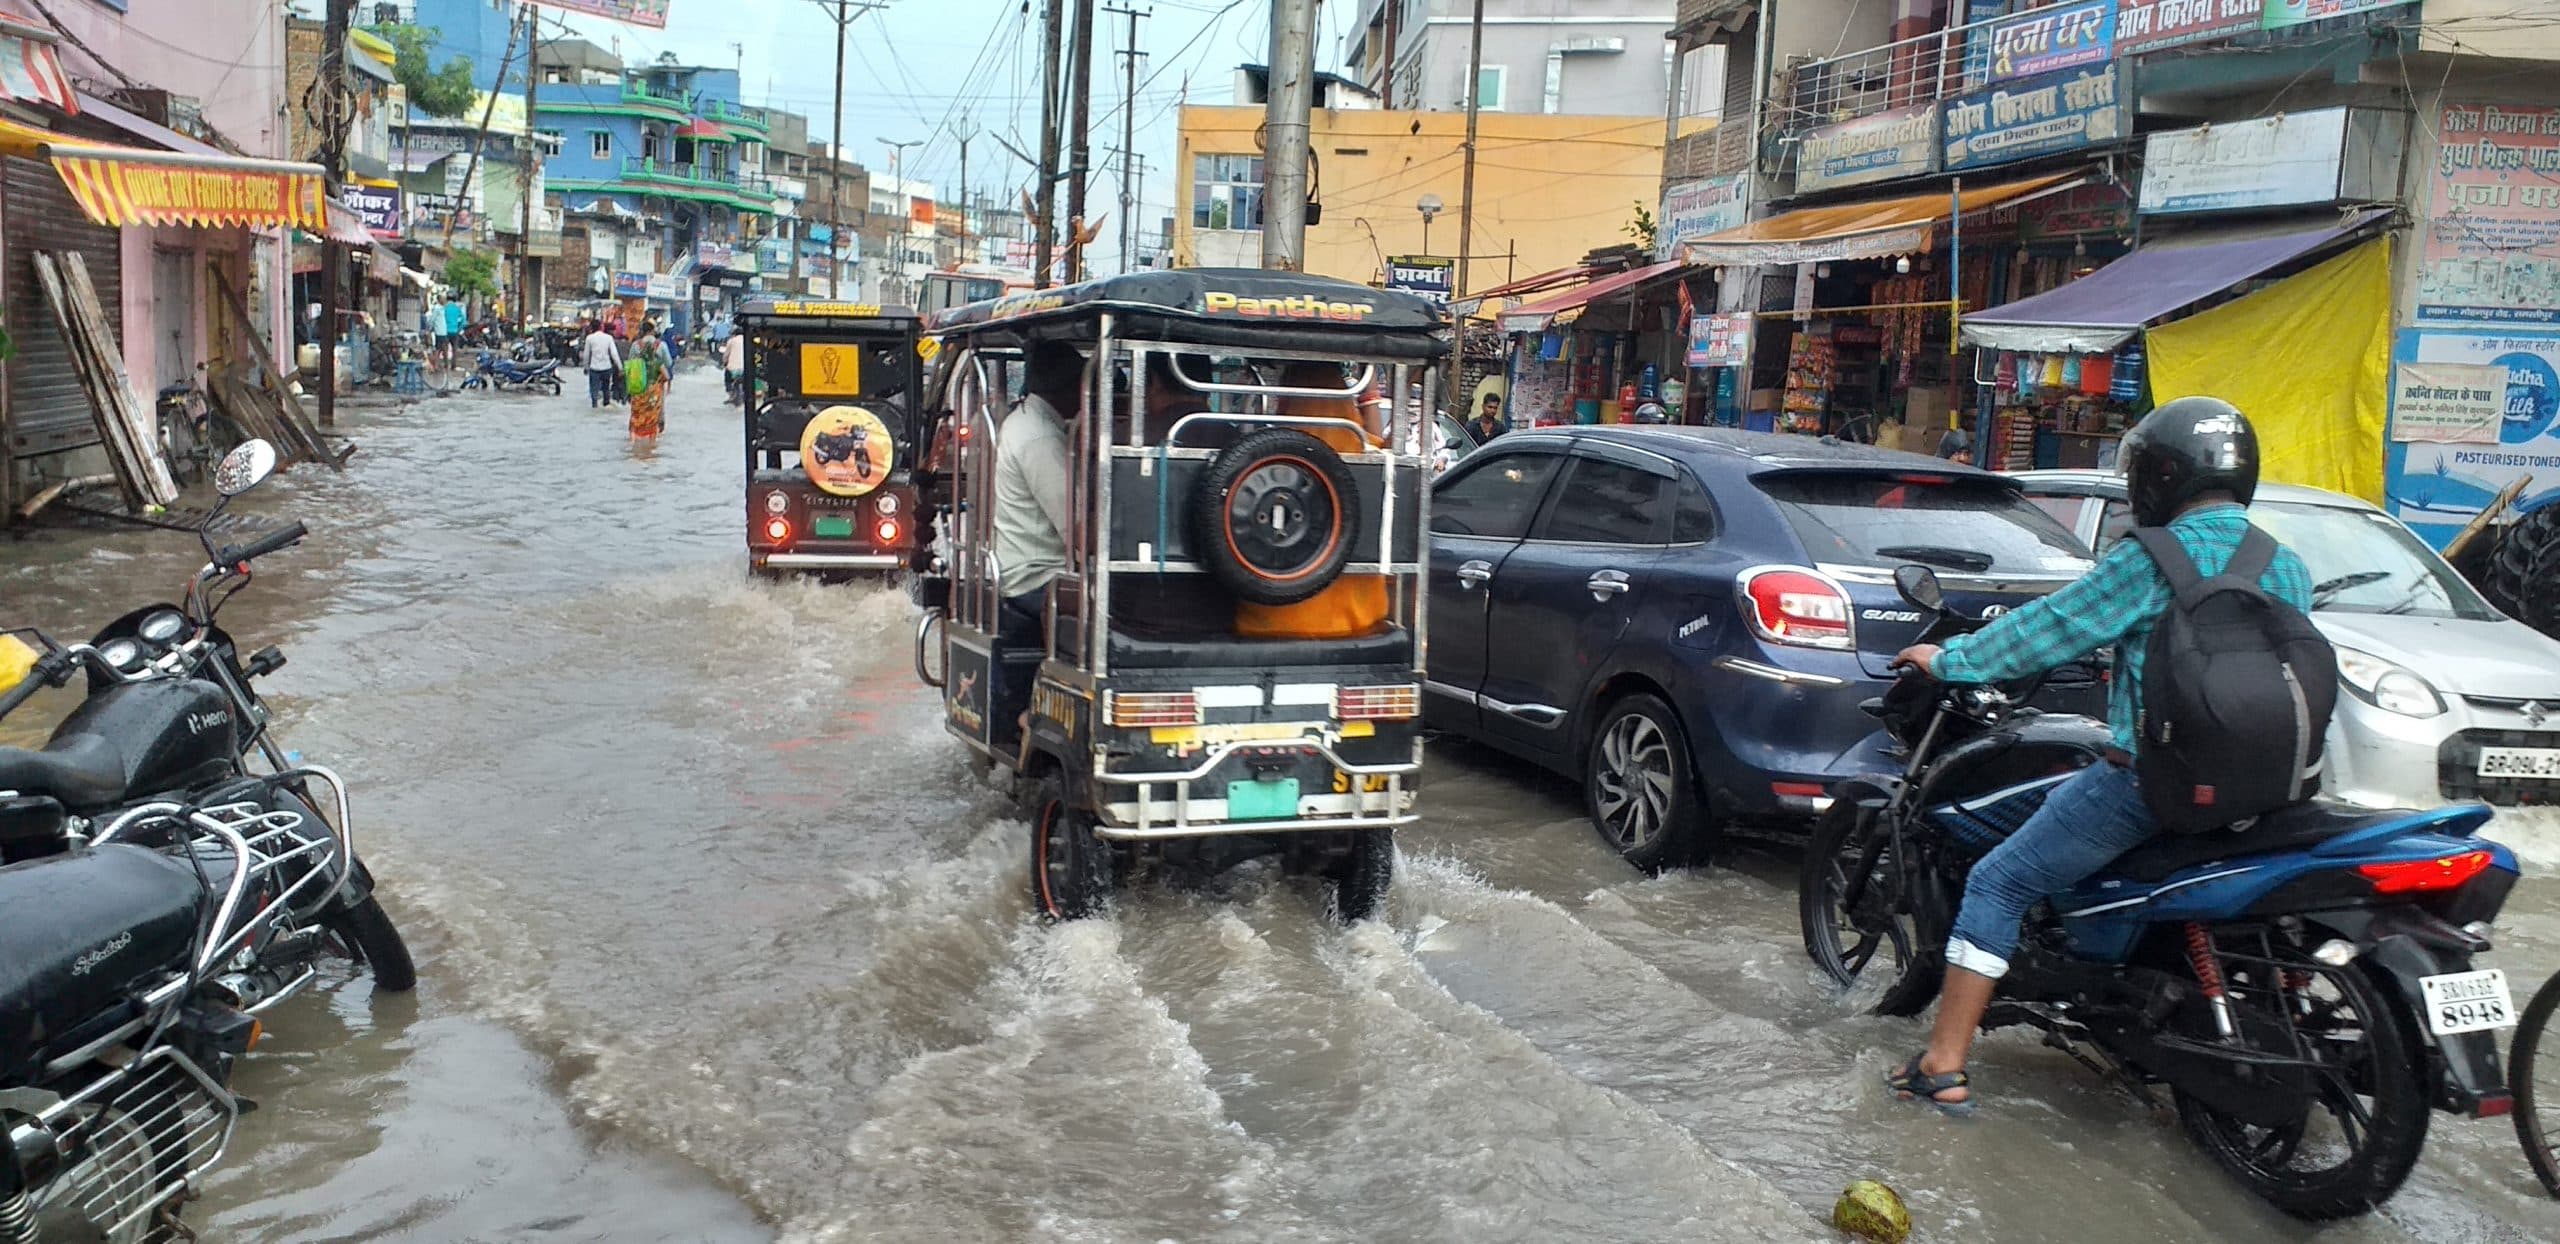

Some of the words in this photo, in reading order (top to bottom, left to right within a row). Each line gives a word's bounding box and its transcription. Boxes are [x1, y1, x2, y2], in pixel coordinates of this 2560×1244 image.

[2116, 0, 2154, 40] ओम
[1994, 16, 2056, 76] पूजा
[2056, 5, 2106, 45] घर
[1947, 101, 1987, 137] ओम
[1991, 86, 2058, 128] किराना
[2063, 64, 2116, 111] स्टोर्स
[2444, 104, 2480, 132] ओम
[2483, 105, 2538, 135] किराना
[403, 133, 466, 152] NTERPRISES
[1801, 133, 1833, 162] ओम
[1838, 128, 1890, 157] किराना
[2440, 143, 2476, 177] सुधा
[2477, 137, 2526, 171] मिल्क
[125, 168, 169, 207] DIVINE
[169, 170, 193, 208] DRY
[195, 172, 233, 210] FRUITS
[235, 177, 244, 210] &
[245, 174, 280, 211] SPICES
[2448, 184, 2514, 214] पूजा
[2520, 185, 2560, 209] घर
[1393, 267, 1444, 283] शर्मा
[1204, 291, 1374, 321] Panther
[2480, 339, 2497, 351] ओम
[2503, 339, 2531, 350] किराना
[2535, 338, 2556, 352] स्टोर
[2507, 368, 2545, 388] udha
[2433, 386, 2458, 401] होटल
[2461, 386, 2470, 401] के
[2473, 389, 2492, 401] पास
[2505, 397, 2535, 416] ilk
[2455, 451, 2528, 466] PASTEURISED
[2529, 455, 2560, 468] TONED
[1680, 614, 1709, 638] PETROL
[1862, 609, 1921, 622] GLANZA
[2484, 755, 2560, 774] BR-09L-2
[1333, 767, 1390, 793] SOP
[2442, 1000, 2504, 1028] 8948
